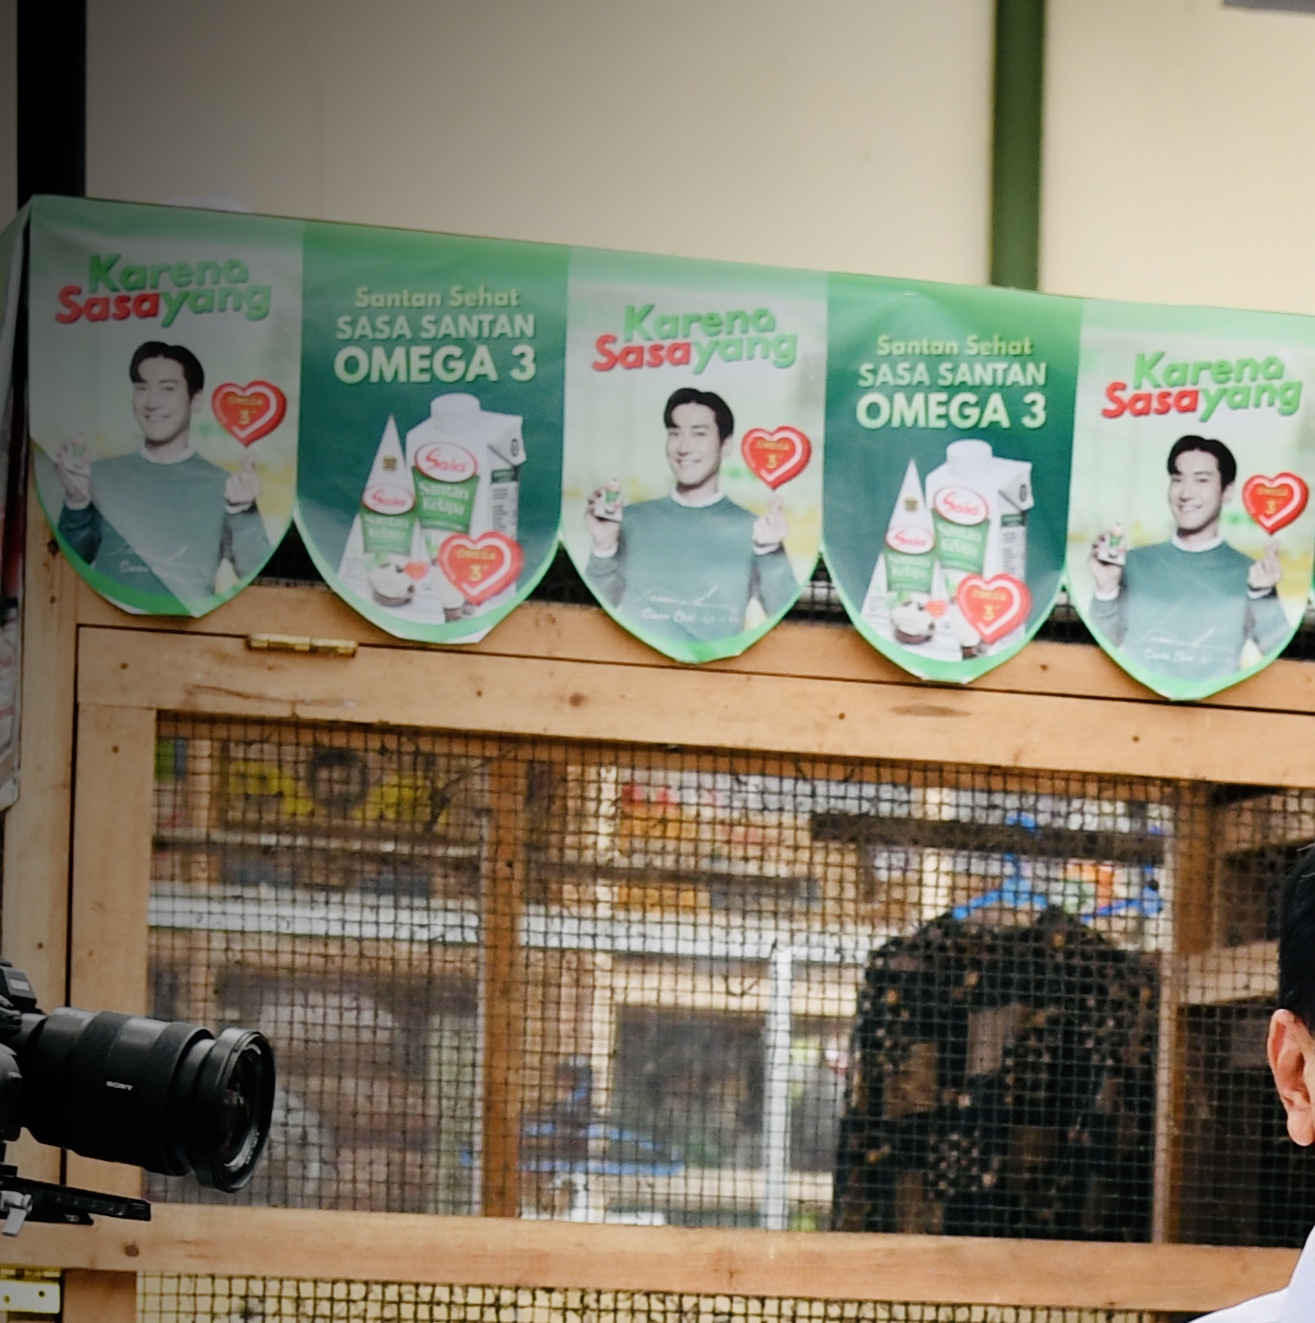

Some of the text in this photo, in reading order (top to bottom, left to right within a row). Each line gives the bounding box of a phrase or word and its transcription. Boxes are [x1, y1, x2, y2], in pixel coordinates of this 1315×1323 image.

[88, 253, 250, 293] Karena
[55, 284, 272, 328] Sasayang
[355, 285, 519, 308] Santan Sehat
[336, 313, 535, 340] SASA SANTAN
[623, 304, 777, 342] Karena
[333, 345, 536, 384] OMEGA 3
[592, 333, 798, 375] Sasayang
[876, 334, 1033, 356] Santan Sehat
[858, 362, 1047, 387] SASA SANTAN
[1133, 351, 1285, 390] Karena
[855, 391, 1047, 430] OMEGA 3
[1101, 380, 1304, 423] Sasayang
